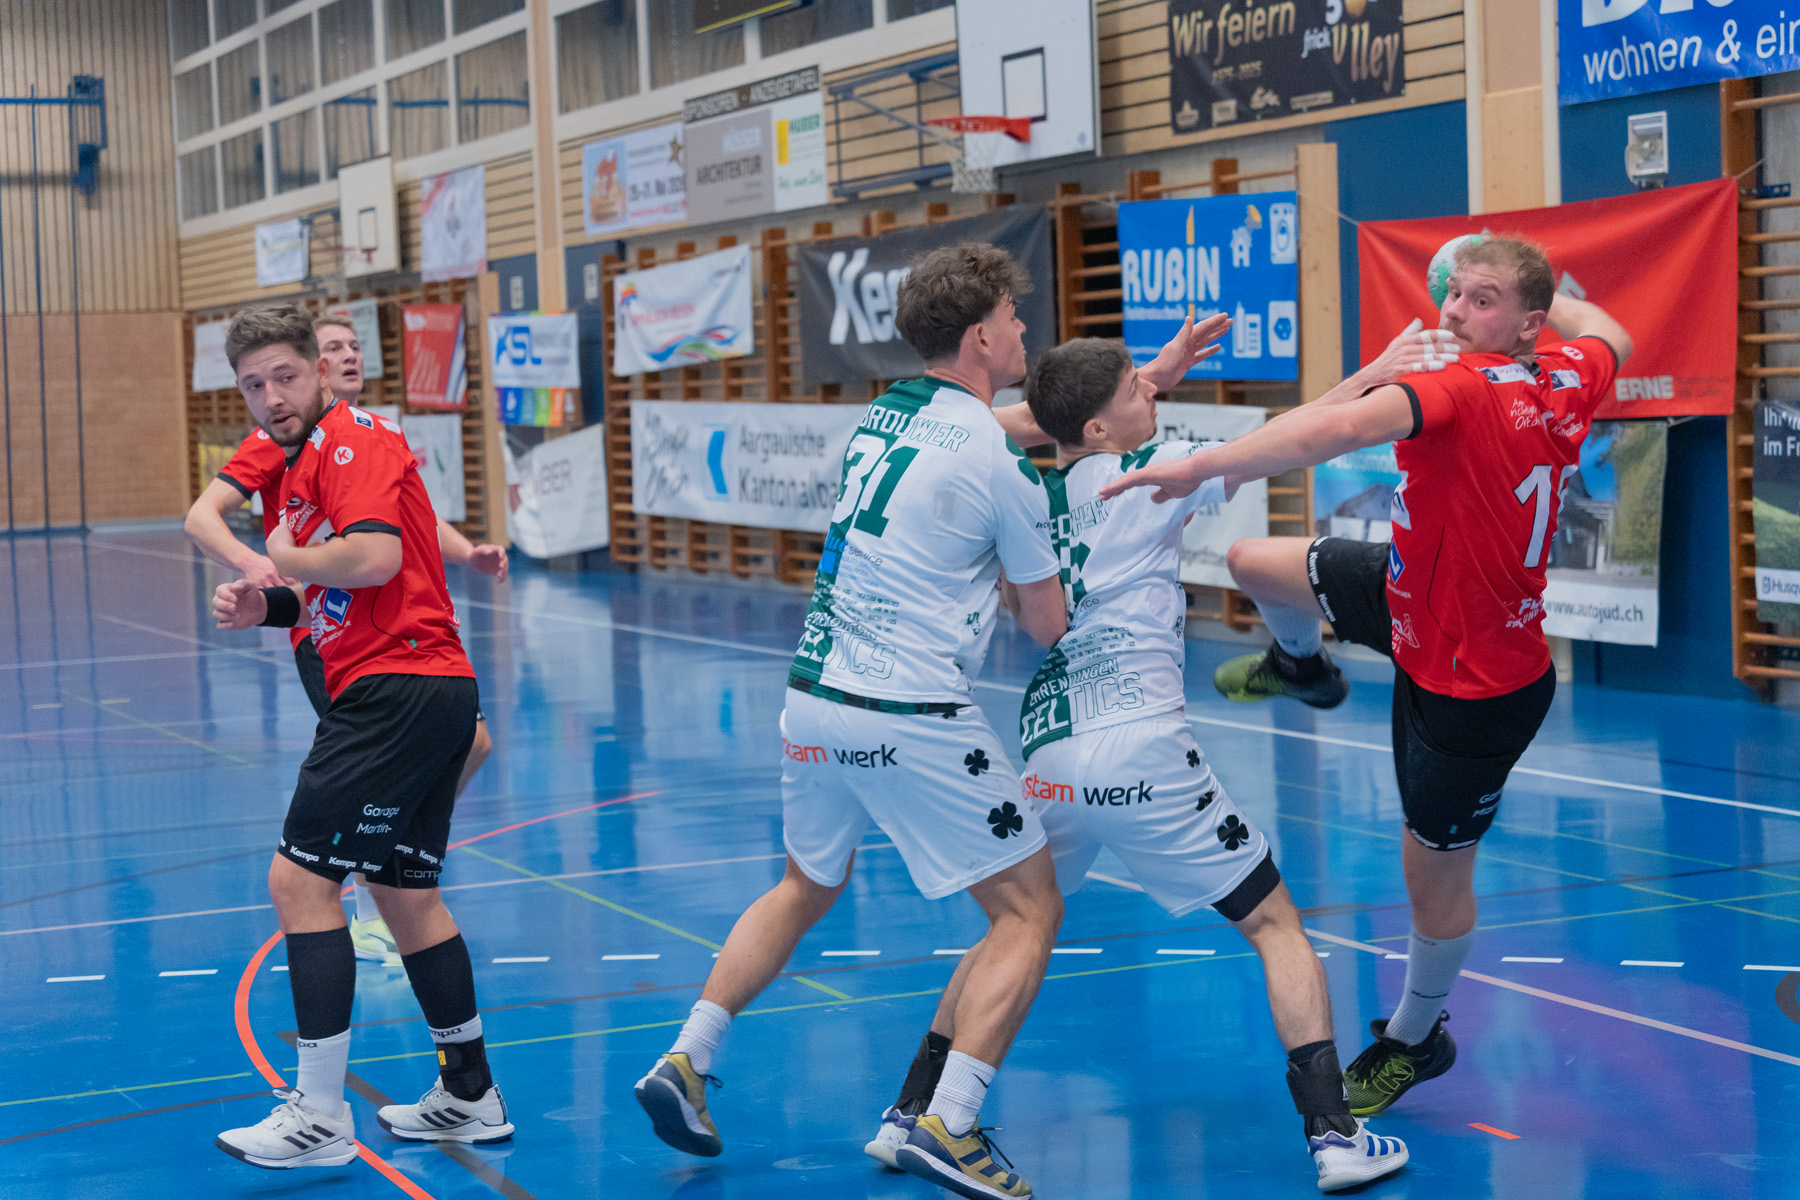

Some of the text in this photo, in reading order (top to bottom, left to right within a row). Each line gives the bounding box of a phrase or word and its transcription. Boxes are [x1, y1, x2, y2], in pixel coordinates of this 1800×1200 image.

[1172, 0, 1296, 66] Wir feiern
[1583, 35, 1702, 84] wohnen
[1715, 19, 1741, 64] &
[695, 154, 762, 186] ARCHITEKTUR
[1122, 246, 1220, 303] RUBIN
[1615, 376, 1674, 401] ERNE
[860, 404, 970, 453] BROUWER
[738, 424, 825, 463] Aargauische
[1764, 435, 1783, 457] im
[831, 433, 920, 538] 31
[849, 544, 883, 567] service
[1030, 657, 1120, 708] EHRENDINGEN
[1021, 671, 1145, 747] CELTICS
[833, 744, 897, 768] werk
[1083, 781, 1152, 806] werk
[363, 803, 401, 818] Garage
[356, 822, 392, 834] Martin-
[290, 845, 320, 863] Kempa
[328, 856, 357, 870] Kempa
